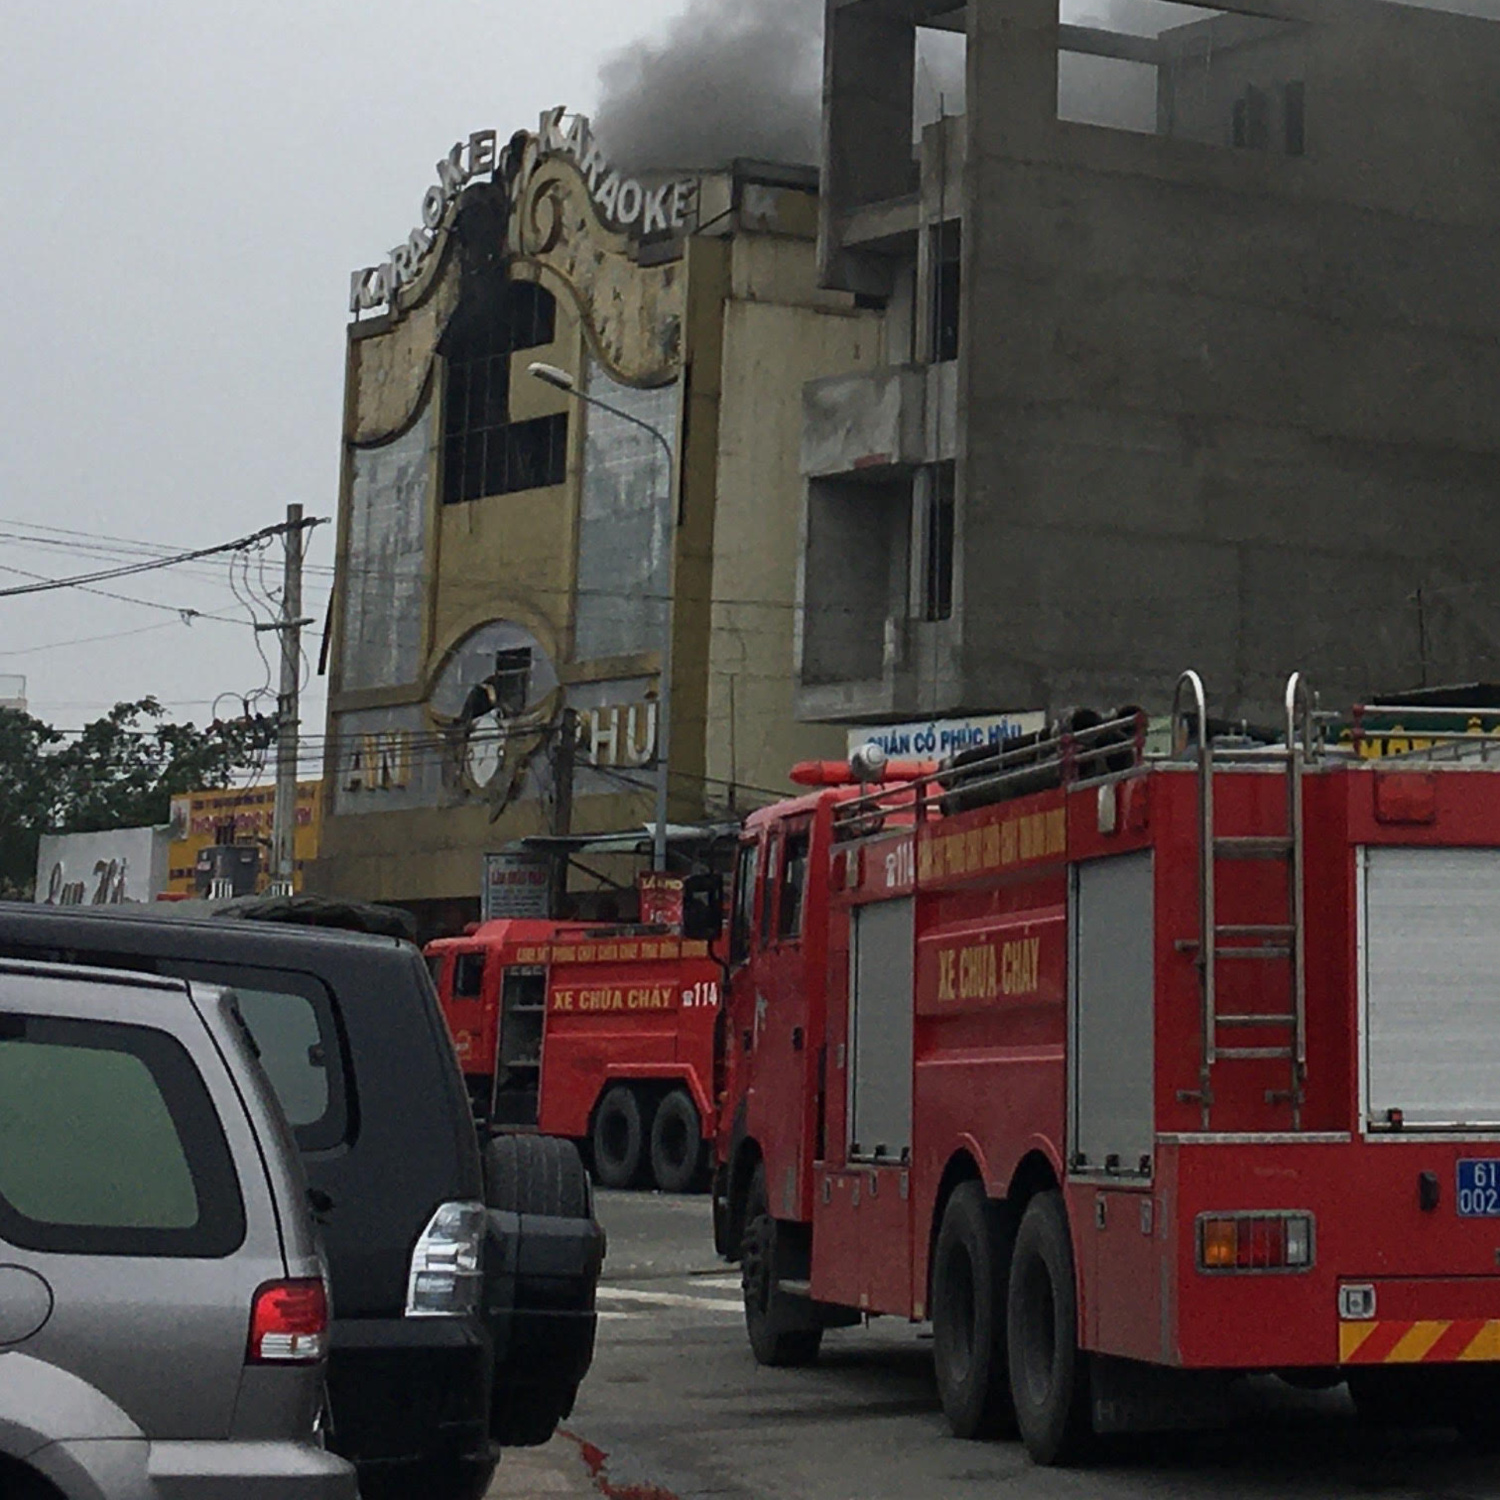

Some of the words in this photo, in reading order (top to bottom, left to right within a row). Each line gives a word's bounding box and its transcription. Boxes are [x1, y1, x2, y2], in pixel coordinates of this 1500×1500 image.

[539, 104, 697, 233] KARAOKE
[349, 129, 497, 312] KARAOKE
[554, 991, 574, 1010] XE
[579, 987, 623, 1011] CHỮA
[627, 983, 672, 1009] CHÁY
[694, 981, 718, 1007] 114
[939, 949, 956, 1000] XE
